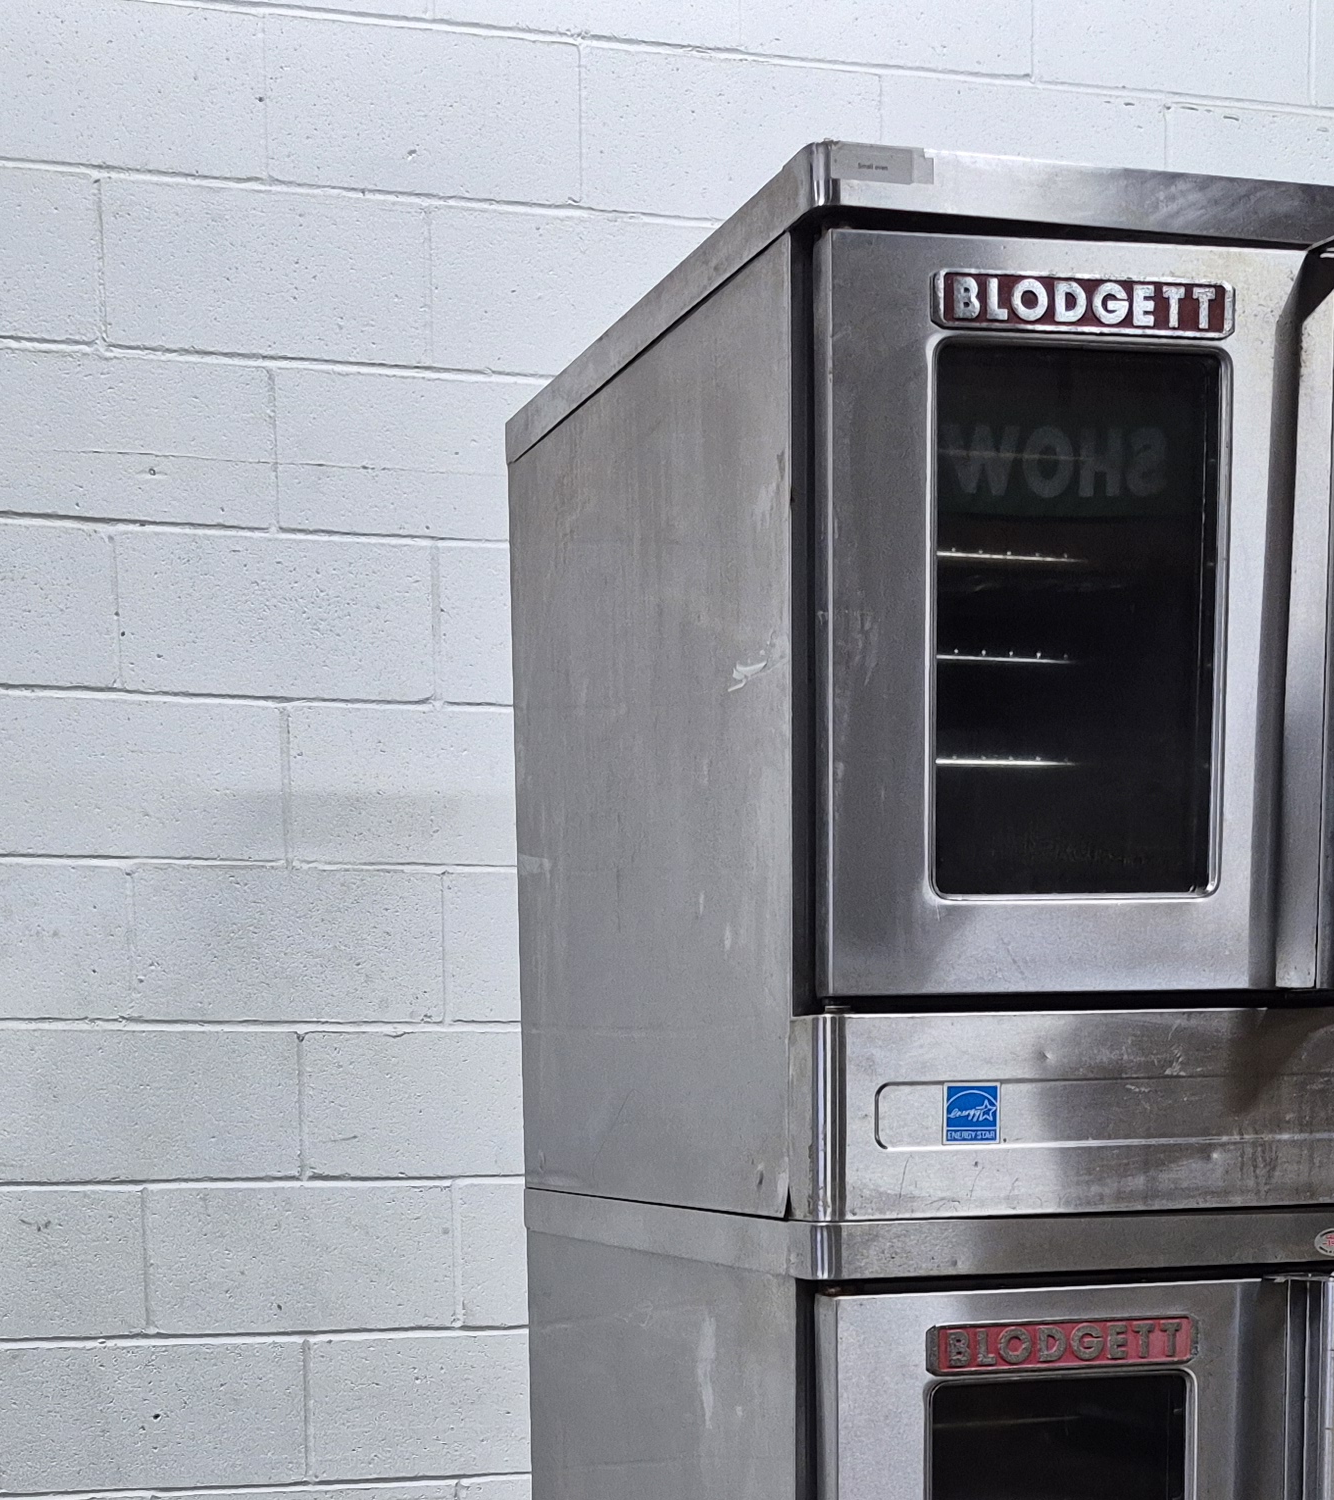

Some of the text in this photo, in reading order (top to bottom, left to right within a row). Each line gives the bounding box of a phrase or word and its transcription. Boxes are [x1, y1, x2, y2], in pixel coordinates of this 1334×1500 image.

[953, 277, 1216, 330] BLODGETT
[947, 1130, 995, 1139] ENERGY STAR
[946, 1321, 1182, 1367] BLODGETT
